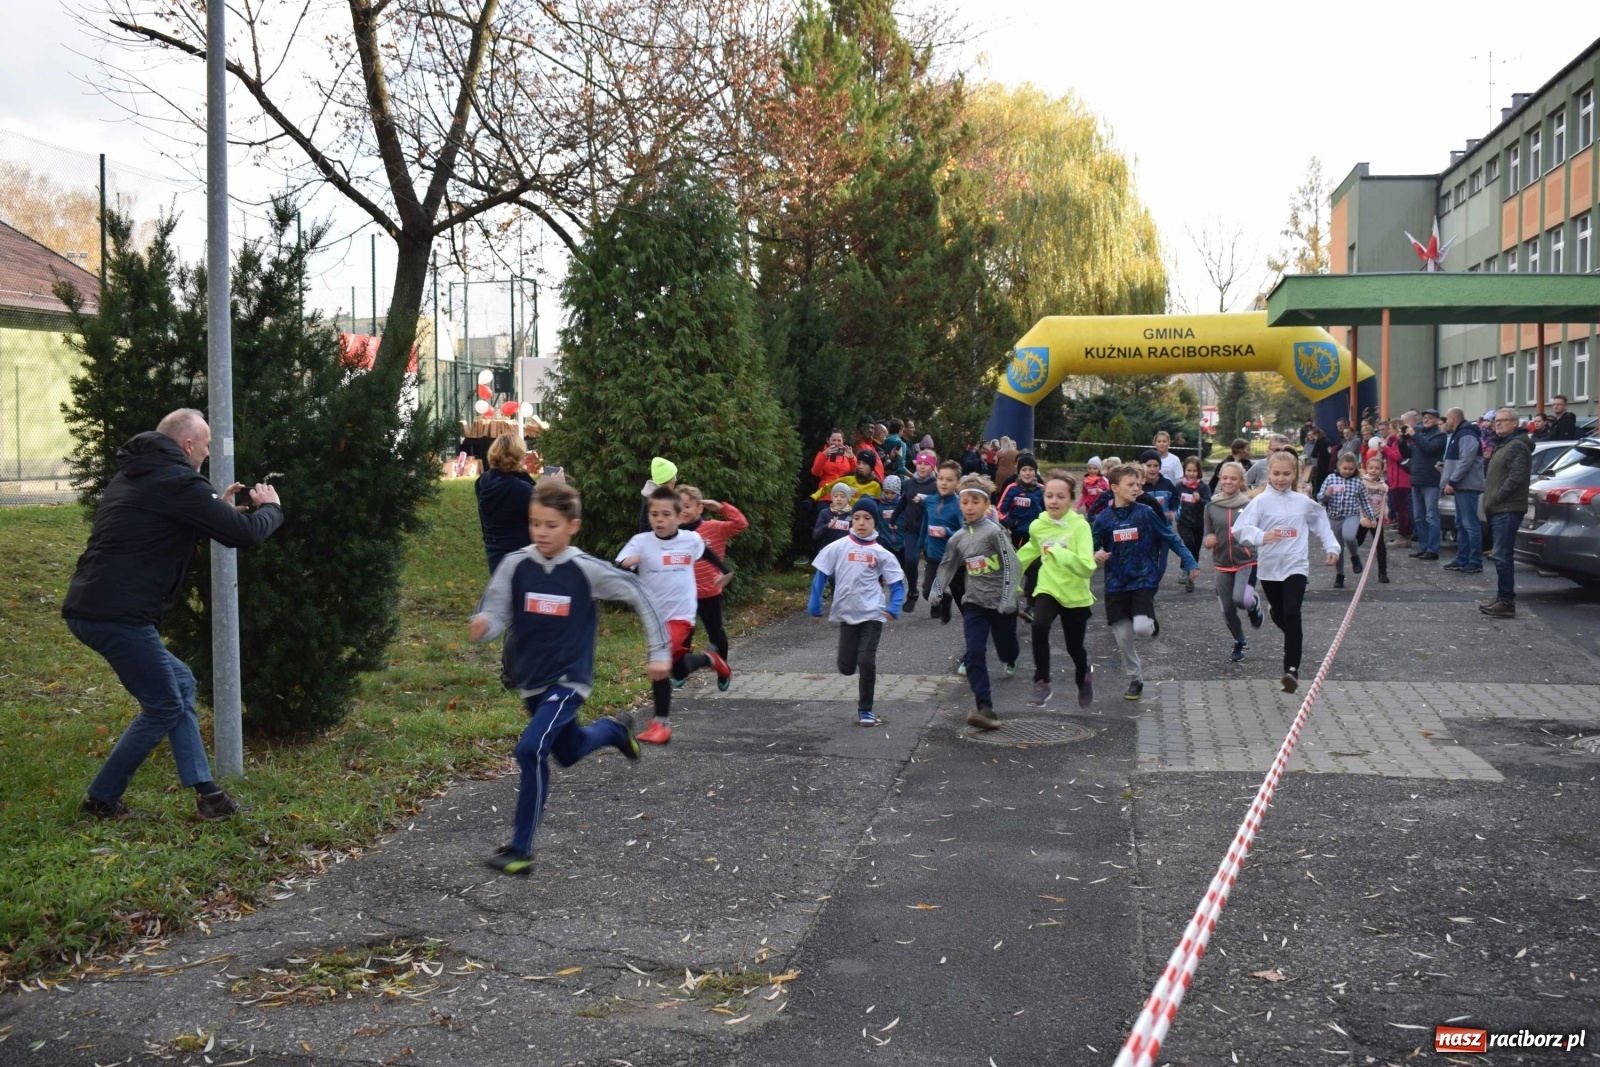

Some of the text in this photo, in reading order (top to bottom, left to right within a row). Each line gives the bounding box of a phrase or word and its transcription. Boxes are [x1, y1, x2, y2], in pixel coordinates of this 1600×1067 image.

[1143, 327, 1195, 340] GMINA
[1084, 344, 1256, 359] KUŹNIA RACIBORSKA
[537, 600, 560, 614] 057
